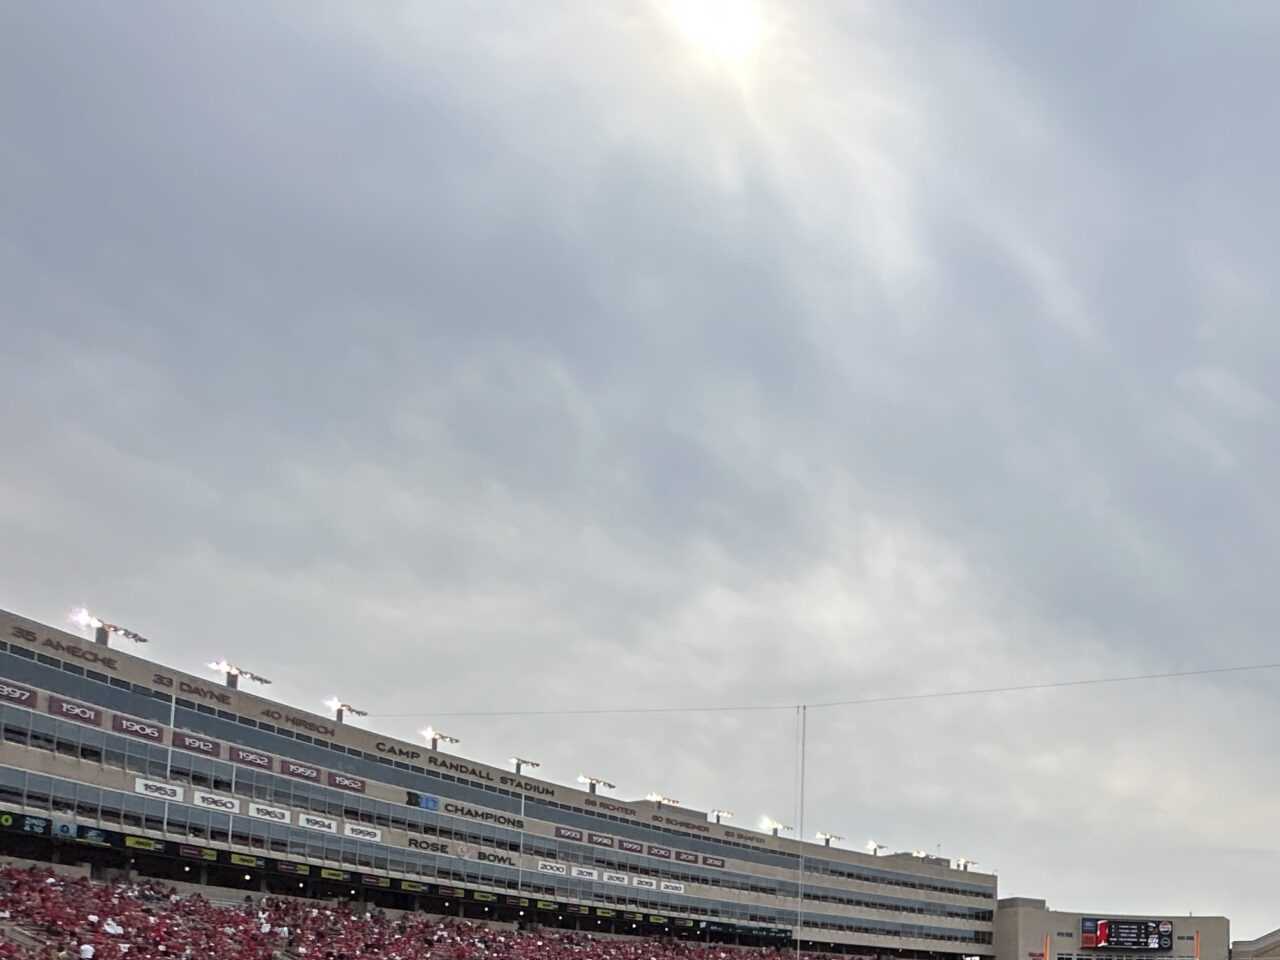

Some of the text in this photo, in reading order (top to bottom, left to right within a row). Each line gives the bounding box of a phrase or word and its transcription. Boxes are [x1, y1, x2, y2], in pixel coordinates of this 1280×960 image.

[42, 638, 118, 671] AMECHE
[0, 684, 31, 701] 897
[179, 681, 232, 705] DAYNE
[61, 703, 96, 720] 1901
[122, 719, 160, 738] 1906
[285, 716, 335, 737] HIRSCH
[184, 737, 213, 752] 1912
[239, 750, 269, 766] 1952
[375, 742, 555, 797] CAMP RANDALL STADIUM
[143, 783, 177, 798] 1953
[335, 775, 362, 790] 1962
[200, 796, 236, 810] 1960
[256, 807, 286, 821] 1963
[444, 803, 525, 829] CHAMPIONS
[305, 817, 333, 831] 1994
[350, 826, 377, 839] 1999
[408, 838, 516, 866] ROSE BOWL
[540, 863, 565, 874] 2000
